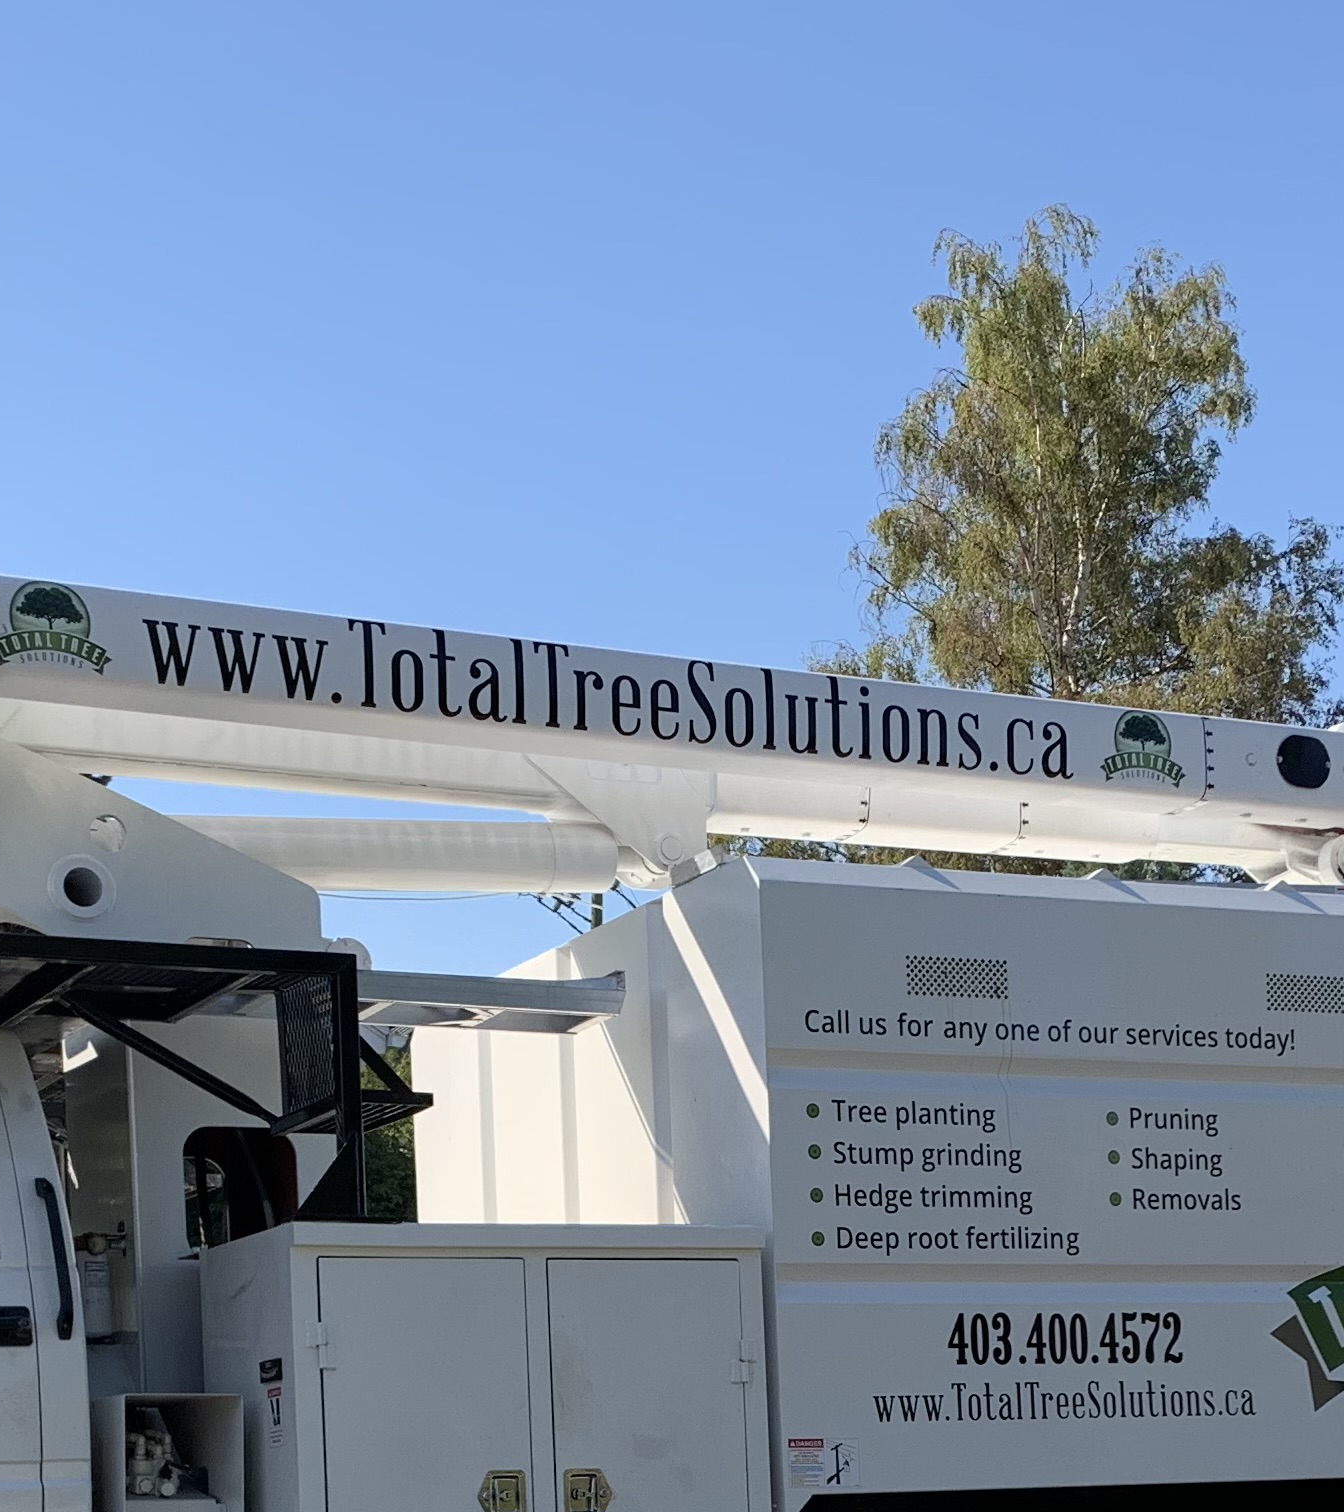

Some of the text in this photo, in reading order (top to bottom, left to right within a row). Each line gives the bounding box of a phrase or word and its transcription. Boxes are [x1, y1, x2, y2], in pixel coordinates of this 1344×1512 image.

[0, 631, 103, 663] TOTAL TREE
[20, 652, 85, 669] SOLUTIONS
[142, 618, 1074, 779] www.TotalTreeSolutions.ca
[1107, 752, 1181, 779] TOTAL TREE
[804, 1009, 1297, 1057] Call us for any one of our services today!
[831, 1099, 997, 1133] Tree planting
[1128, 1107, 1219, 1137] Pruning
[832, 1141, 1023, 1173] Stump grinding
[1131, 1147, 1223, 1177] Shaping
[834, 1184, 1033, 1215] Hedge trimming
[1132, 1188, 1242, 1212] Removals
[836, 1225, 1080, 1257] Deep root fertilizing
[947, 1311, 1184, 1366] 403.400.4572
[873, 1380, 1256, 1422] www.TotalTreeSolutions.ca
